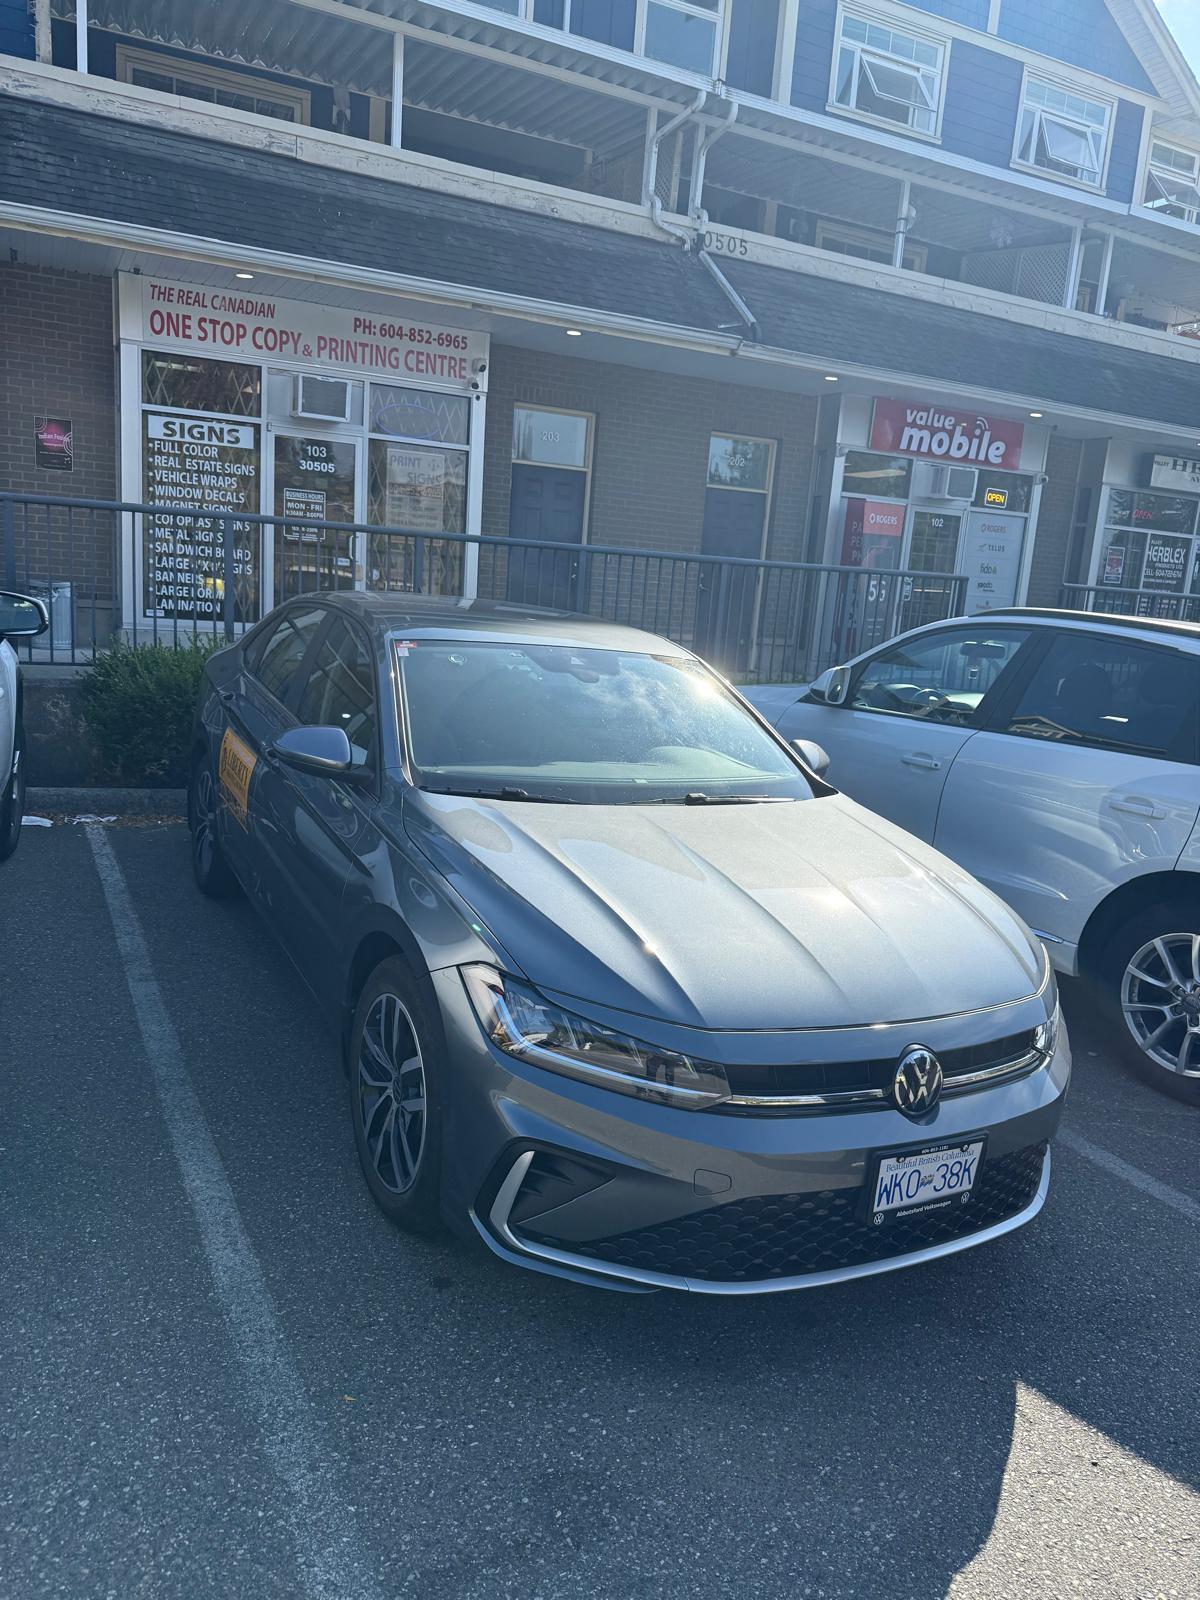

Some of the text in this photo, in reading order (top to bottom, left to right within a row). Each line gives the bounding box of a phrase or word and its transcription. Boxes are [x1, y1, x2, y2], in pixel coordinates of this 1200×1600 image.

[150, 284, 276, 319] THE REAL CANADIAN
[353, 316, 468, 350] PH: 604-852-6965
[149, 309, 467, 380] ONE STOP COPY & PRINTING CENTRE
[905, 408, 956, 430] value
[162, 420, 241, 445] SIGNS
[541, 430, 560, 443] 203
[154, 440, 219, 458] FULL COLOR
[305, 445, 327, 458] 103
[899, 425, 1007, 465] mobile
[154, 454, 256, 477] REAL ESTATE SIGNS
[299, 459, 336, 473] 30505
[390, 454, 422, 469] PRINT
[154, 469, 238, 489] VEHICLE WRAPS
[154, 484, 245, 504] WINDOW DECALS
[986, 492, 1006, 504] OPEN
[287, 501, 306, 510] MON
[310, 503, 323, 511] FRI
[876, 514, 898, 525] ROGERS
[931, 518, 944, 528] 102
[988, 544, 1005, 553] TELUS
[886, 1157, 918, 1172] Beautiful
[918, 1154, 941, 1166] British
[933, 1156, 977, 1193] 38K
[896, 1200, 952, 1218] Abbotsford Volkswagen
